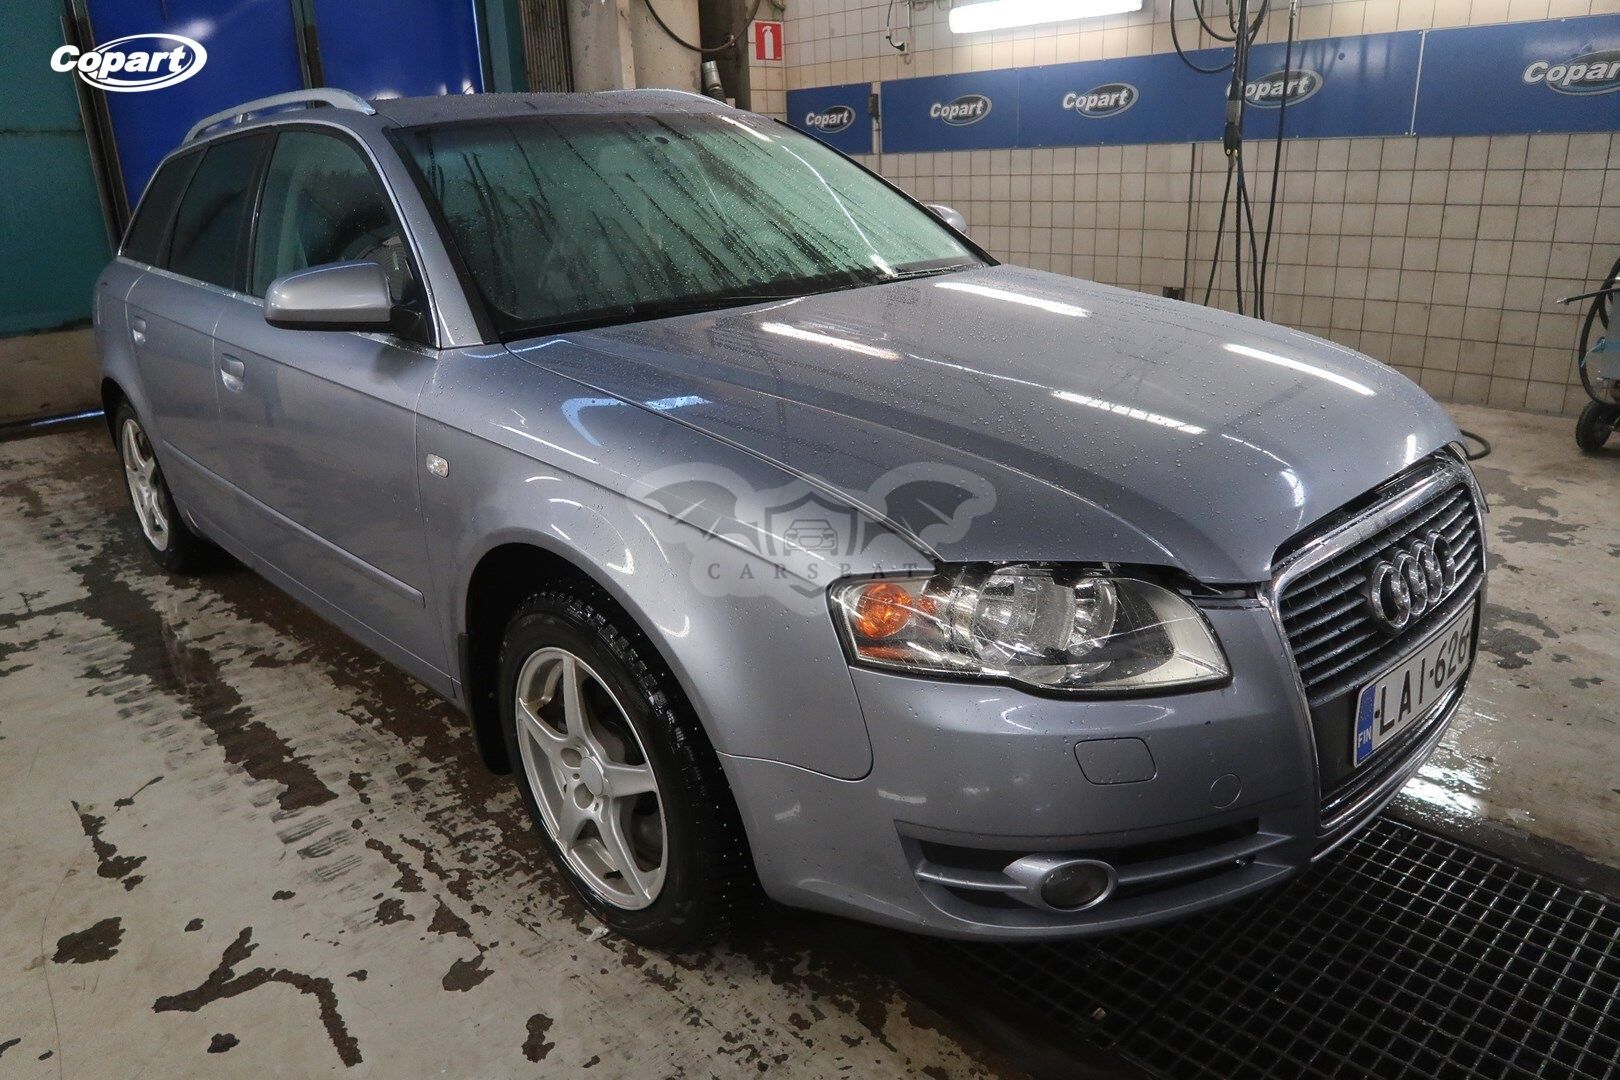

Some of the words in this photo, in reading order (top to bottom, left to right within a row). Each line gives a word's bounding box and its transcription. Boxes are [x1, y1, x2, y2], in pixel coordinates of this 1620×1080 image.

[1523, 61, 1620, 86] Copar
[930, 100, 985, 120] Copart
[1062, 89, 1128, 111] Copart
[806, 111, 849, 126] Copart
[1379, 616, 1470, 737] LAI-626
[1357, 725, 1373, 748] FIN
